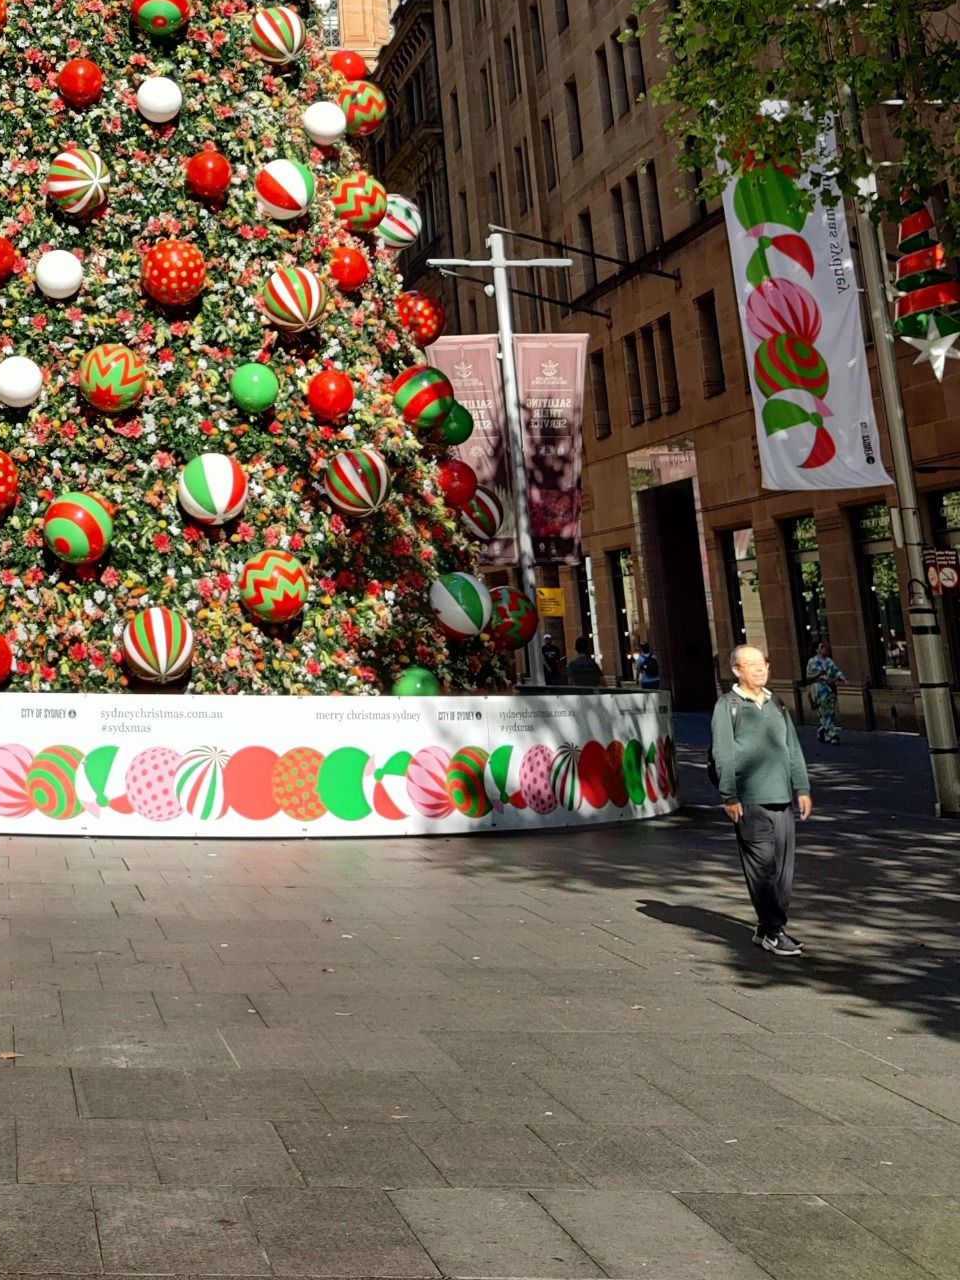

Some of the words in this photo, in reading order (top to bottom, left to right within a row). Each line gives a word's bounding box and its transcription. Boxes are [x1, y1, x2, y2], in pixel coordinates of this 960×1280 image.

[20, 708, 35, 718] CITY
[35, 708, 43, 718] OF
[44, 708, 66, 718] SYDNEY
[100, 707, 224, 720] sydneychristmas.com.au
[315, 711, 345, 722] merry
[346, 708, 391, 720] christmas
[392, 709, 422, 723] sydney
[456, 711, 475, 720] SYDNEY
[101, 721, 152, 734] #sydxmas
[501, 722, 535, 733] #sydxmas
